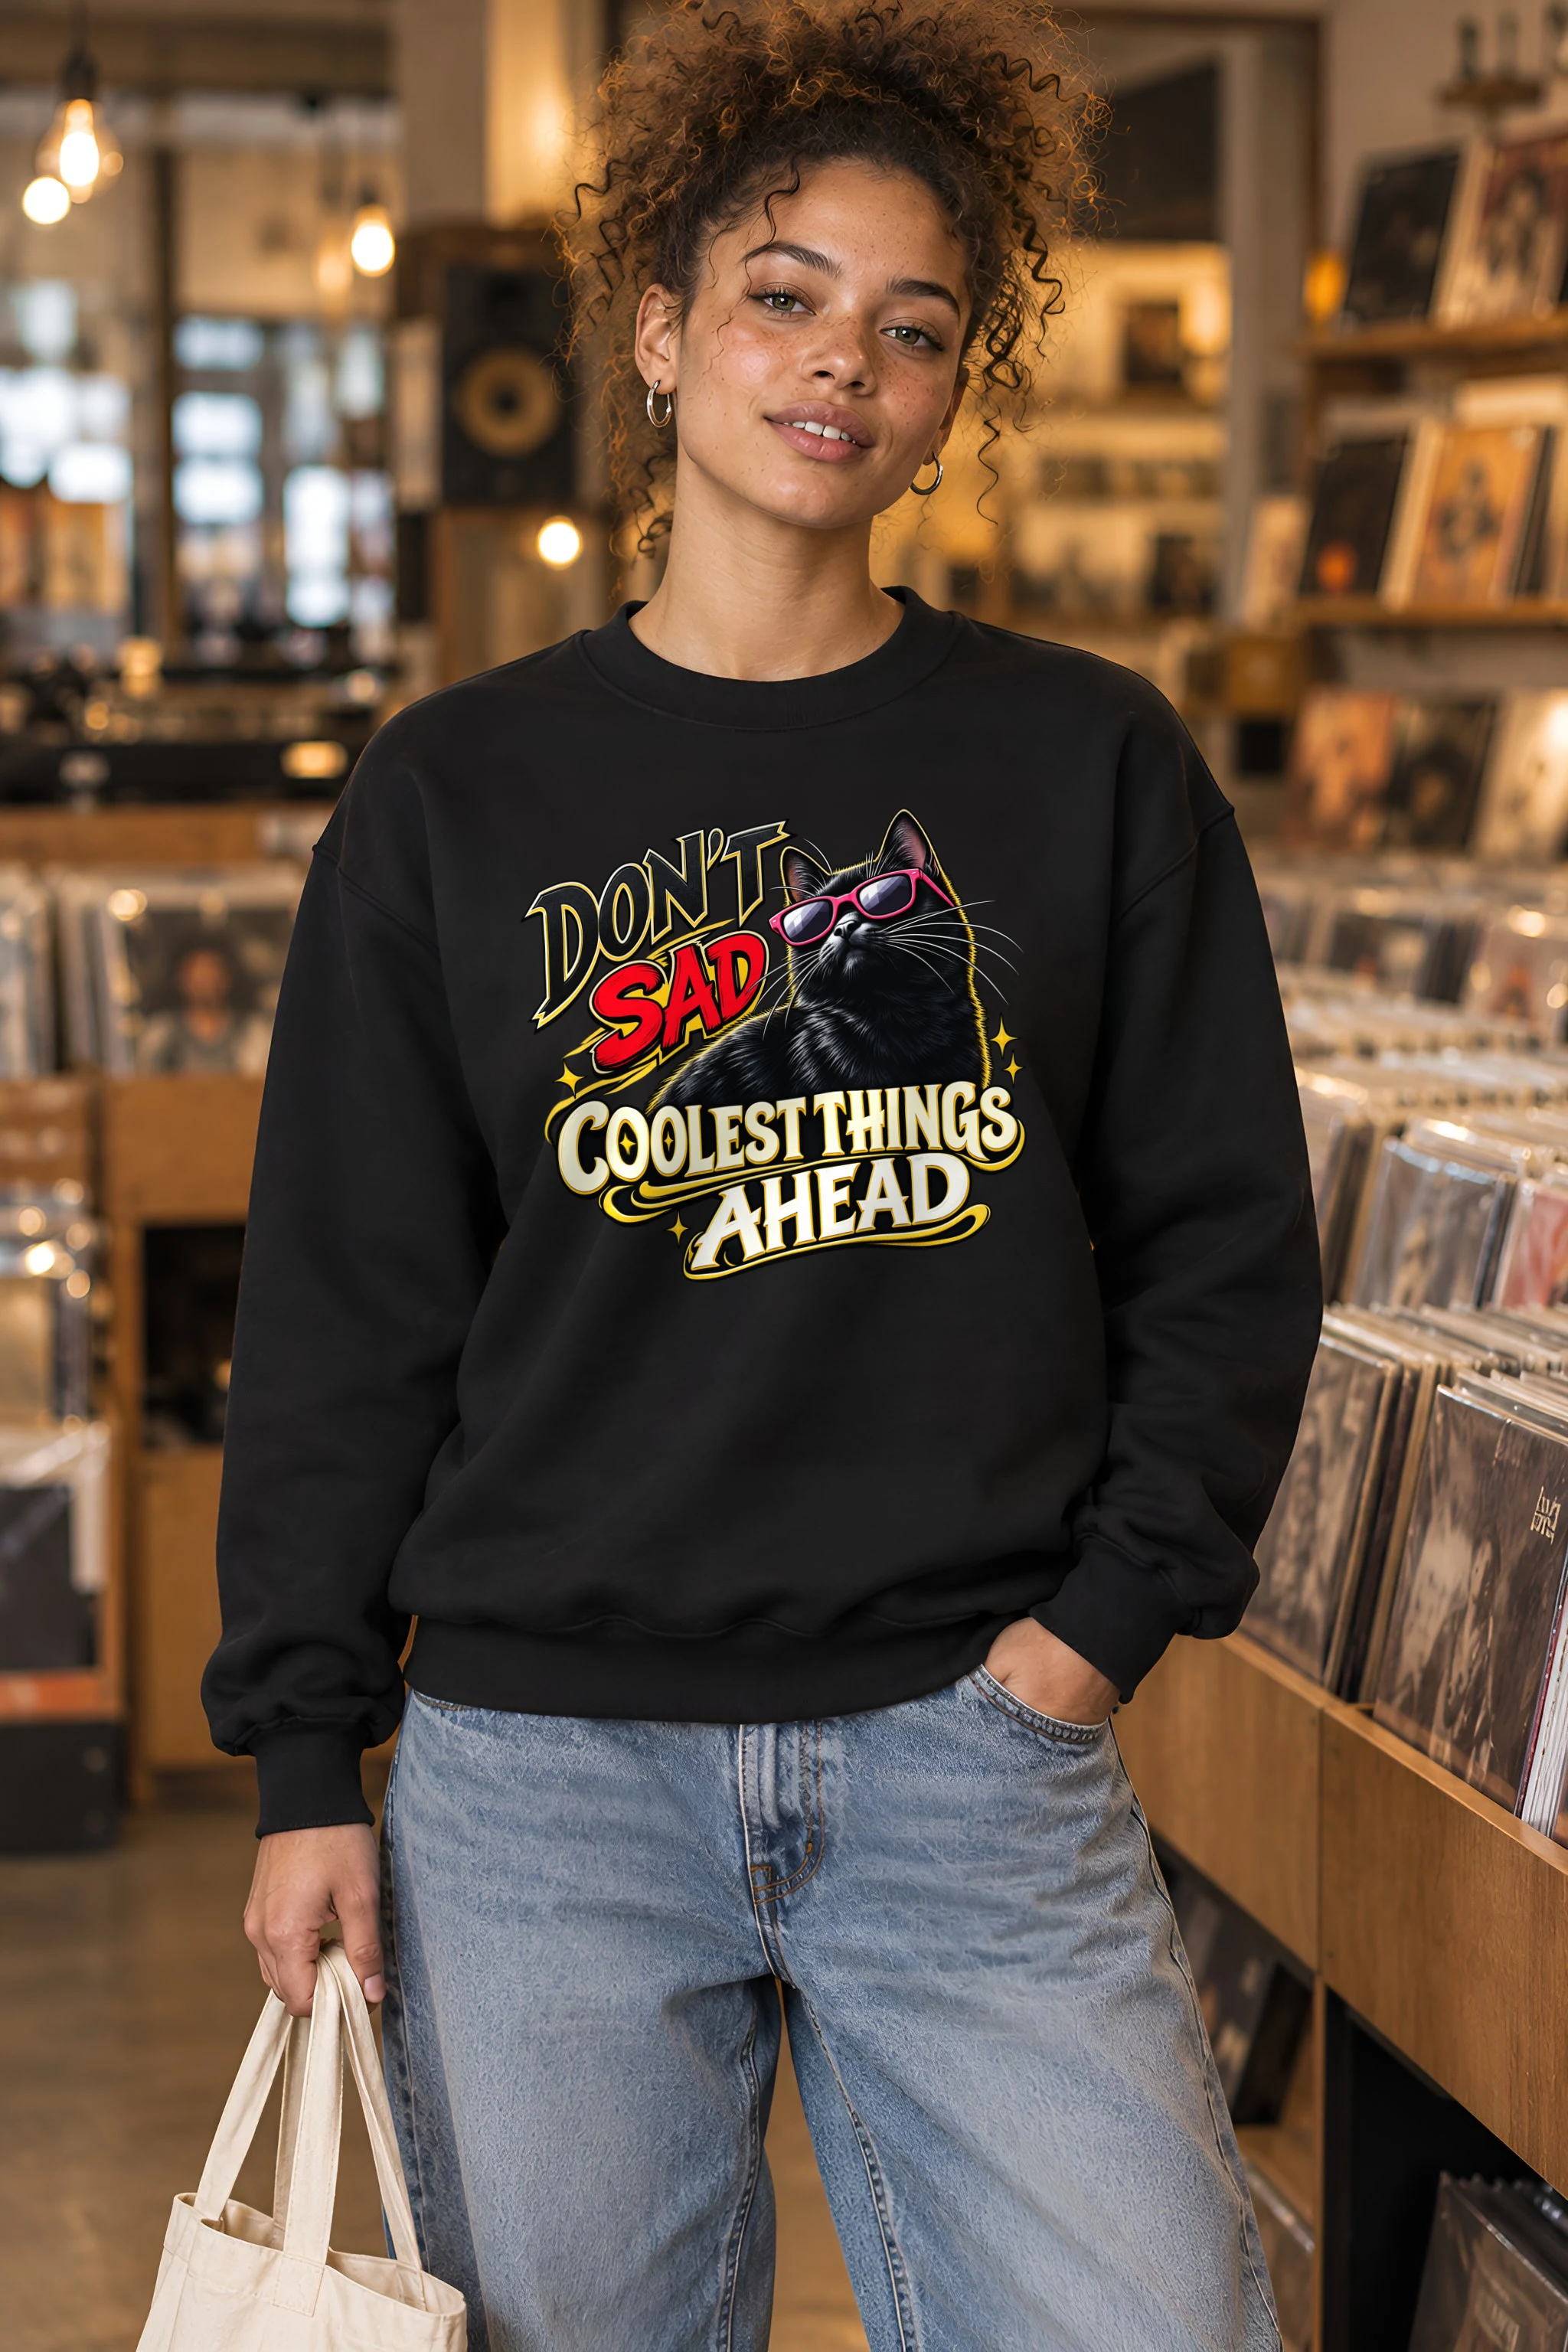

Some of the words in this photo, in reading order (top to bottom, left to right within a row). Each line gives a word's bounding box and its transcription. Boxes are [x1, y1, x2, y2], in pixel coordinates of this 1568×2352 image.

[524, 819, 792, 1029] DON'T
[590, 932, 769, 1073] SAD
[557, 1096, 807, 1195] COOLEST
[813, 1081, 1018, 1161] THINGS
[690, 1152, 970, 1271] AHEAD
